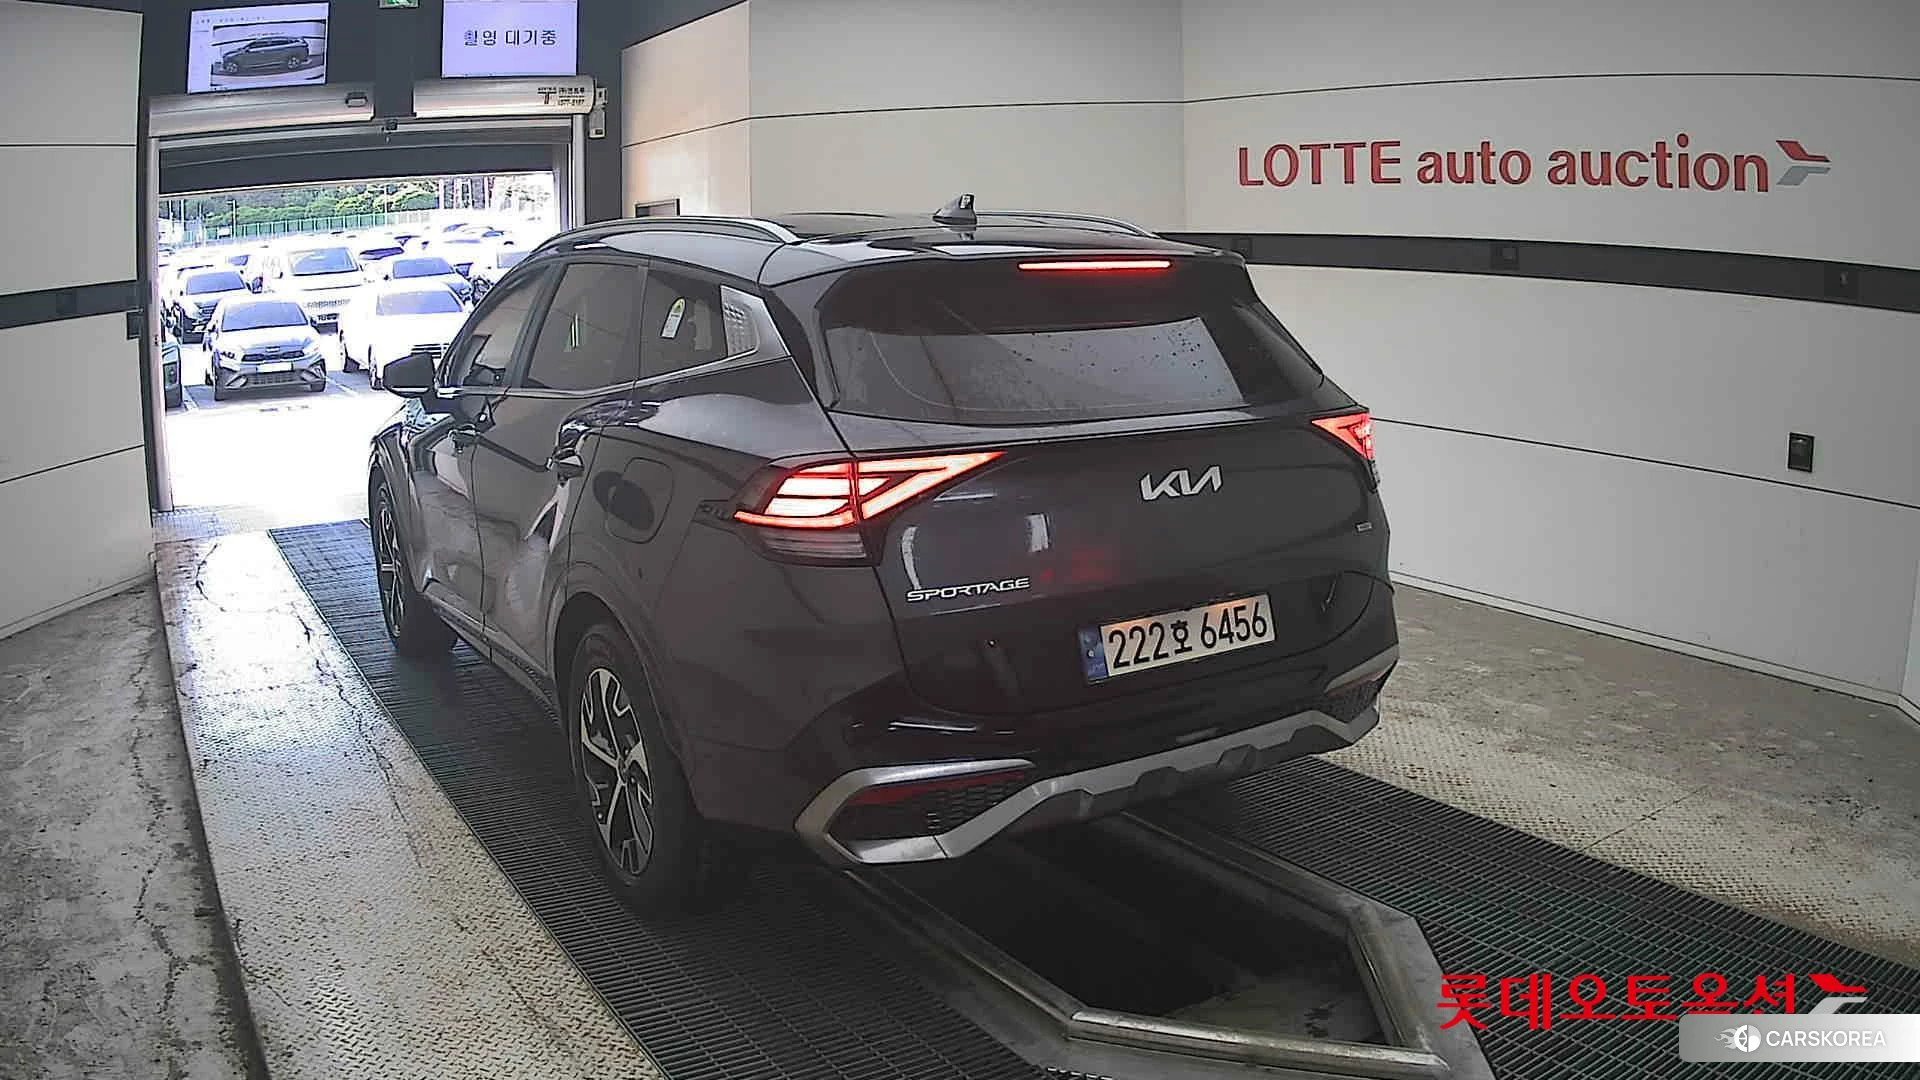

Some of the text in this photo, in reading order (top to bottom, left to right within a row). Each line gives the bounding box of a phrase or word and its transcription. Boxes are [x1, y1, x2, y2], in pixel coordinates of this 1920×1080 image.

[505, 29, 557, 46] 대기중
[1238, 133, 1769, 192] LOTTE auto auction
[1140, 465, 1222, 500] KIA
[906, 578, 1031, 602] SPORTAGE
[1108, 602, 1267, 669] 222호 6456
